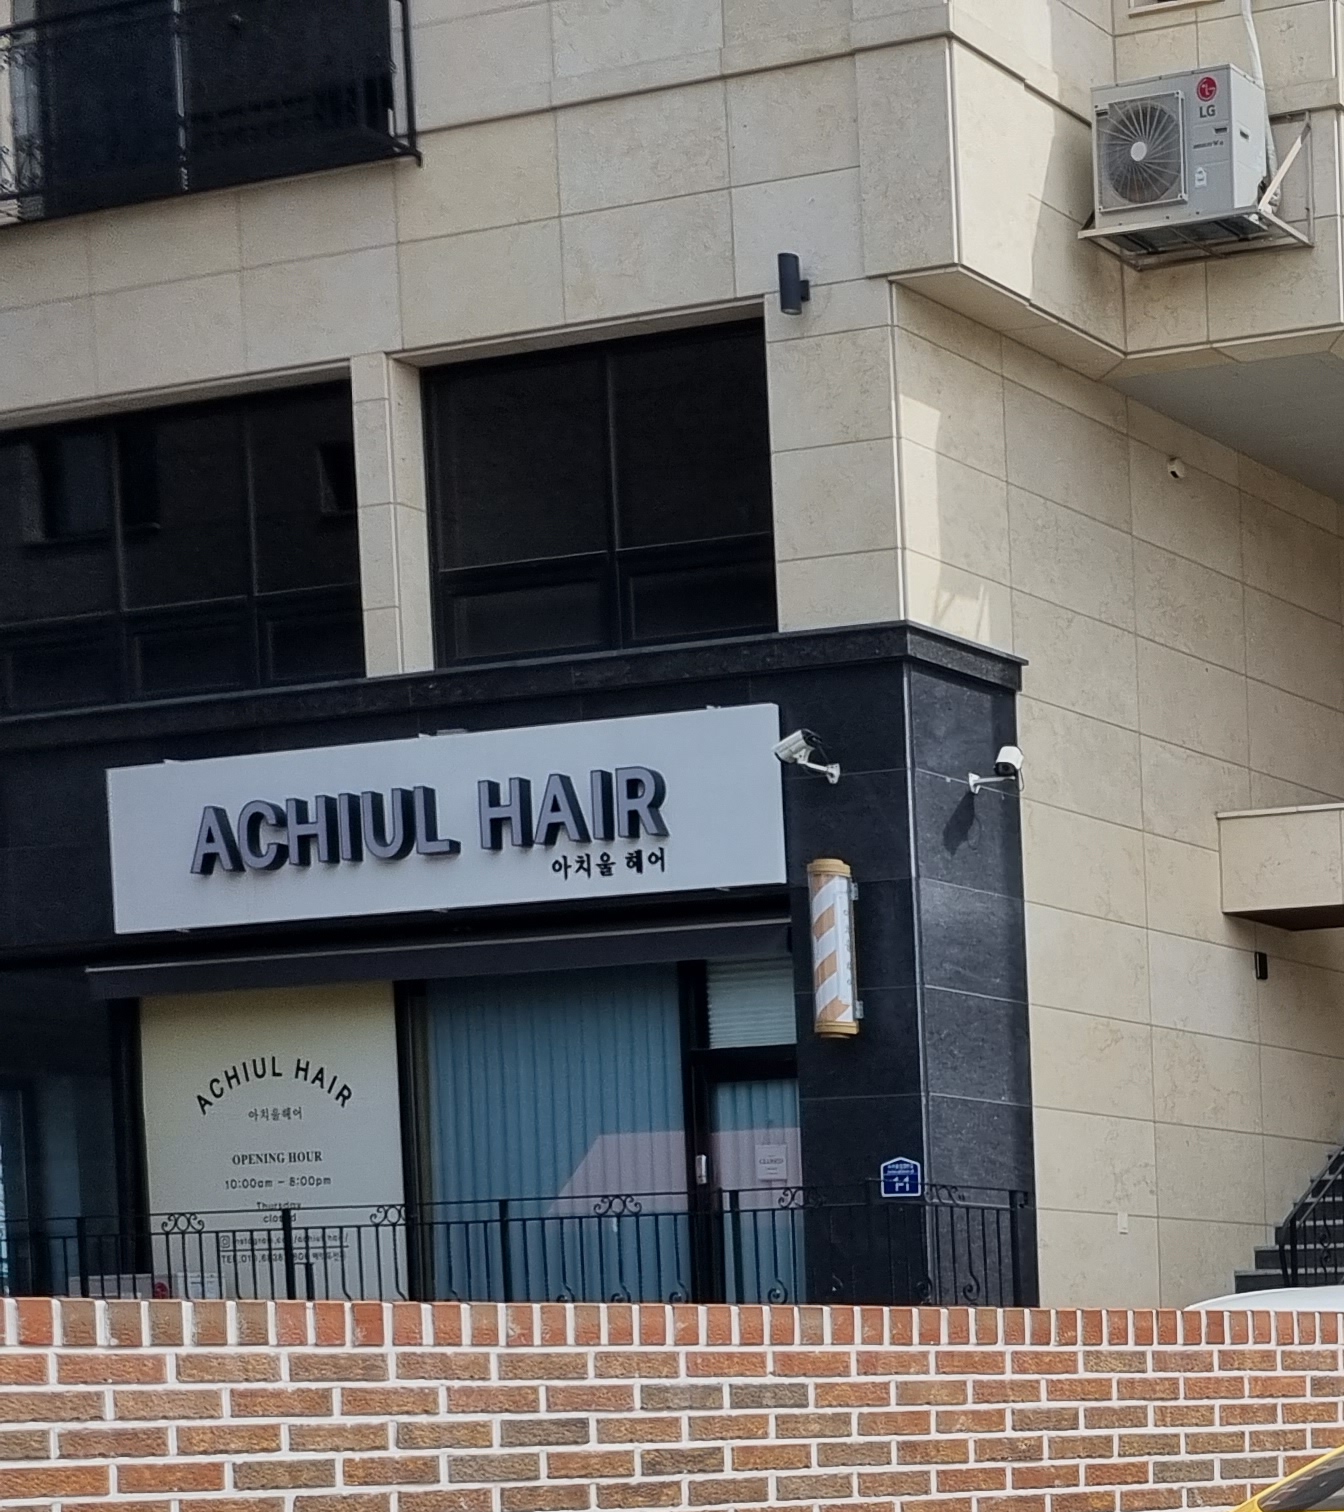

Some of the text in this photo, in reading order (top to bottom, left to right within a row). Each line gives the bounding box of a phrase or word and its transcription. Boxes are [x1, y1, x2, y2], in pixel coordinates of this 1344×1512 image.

[1199, 104, 1216, 118] LG
[191, 766, 669, 875] ACHIUL HAIR
[552, 846, 664, 881] 아치울 헤어
[196, 1056, 352, 1116] ACHIUL HAIR
[232, 1151, 322, 1166] OPENING HOUR
[225, 1178, 273, 1190] 10:00am
